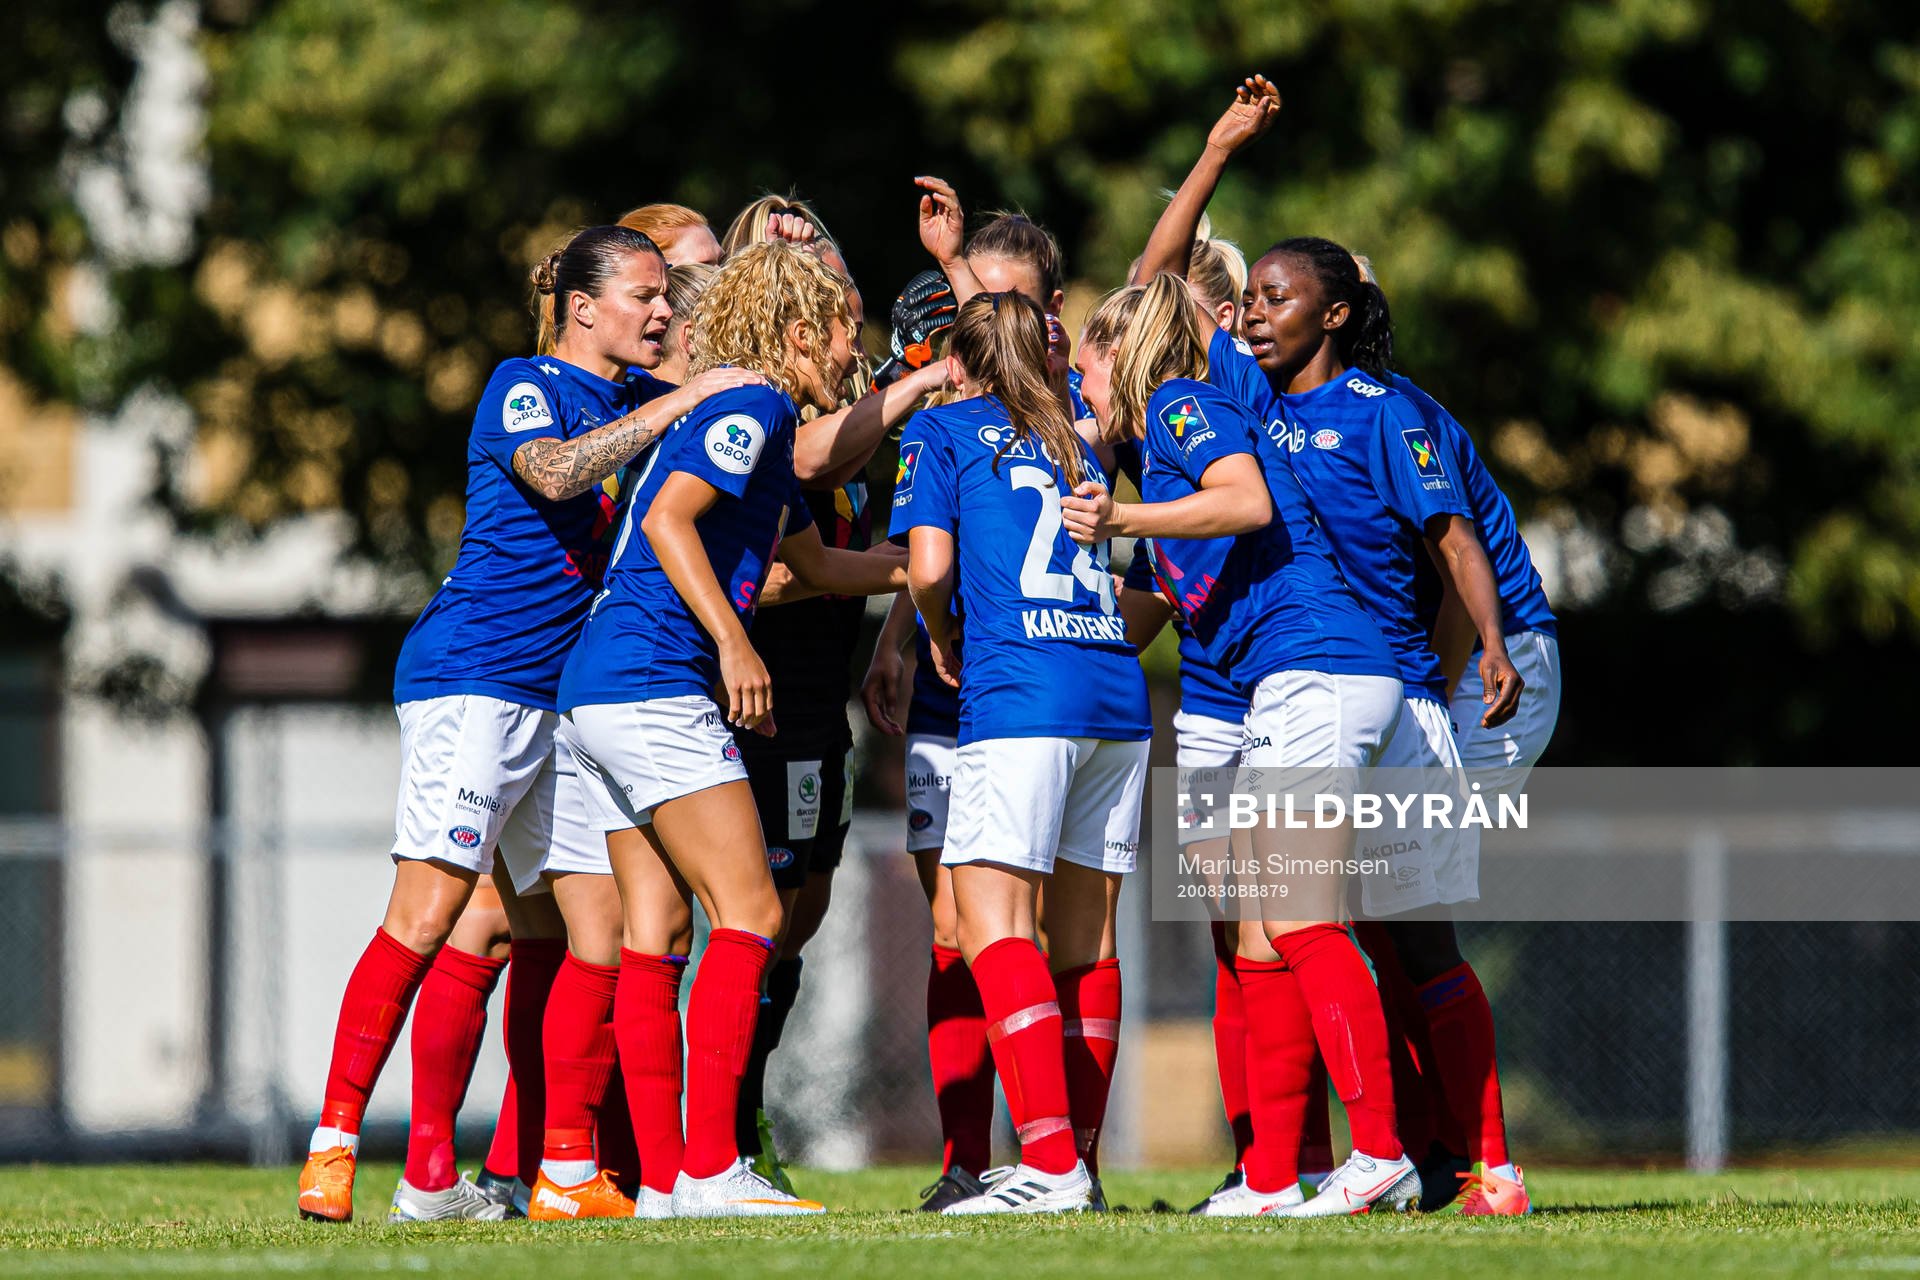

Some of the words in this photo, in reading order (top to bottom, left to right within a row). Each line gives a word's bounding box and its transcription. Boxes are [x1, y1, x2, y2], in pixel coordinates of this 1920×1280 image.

[1346, 378, 1387, 397] coop
[512, 408, 549, 426] OBOS
[1268, 419, 1306, 453] DNB
[713, 441, 752, 466] OBOS
[1010, 465, 1115, 616] 24
